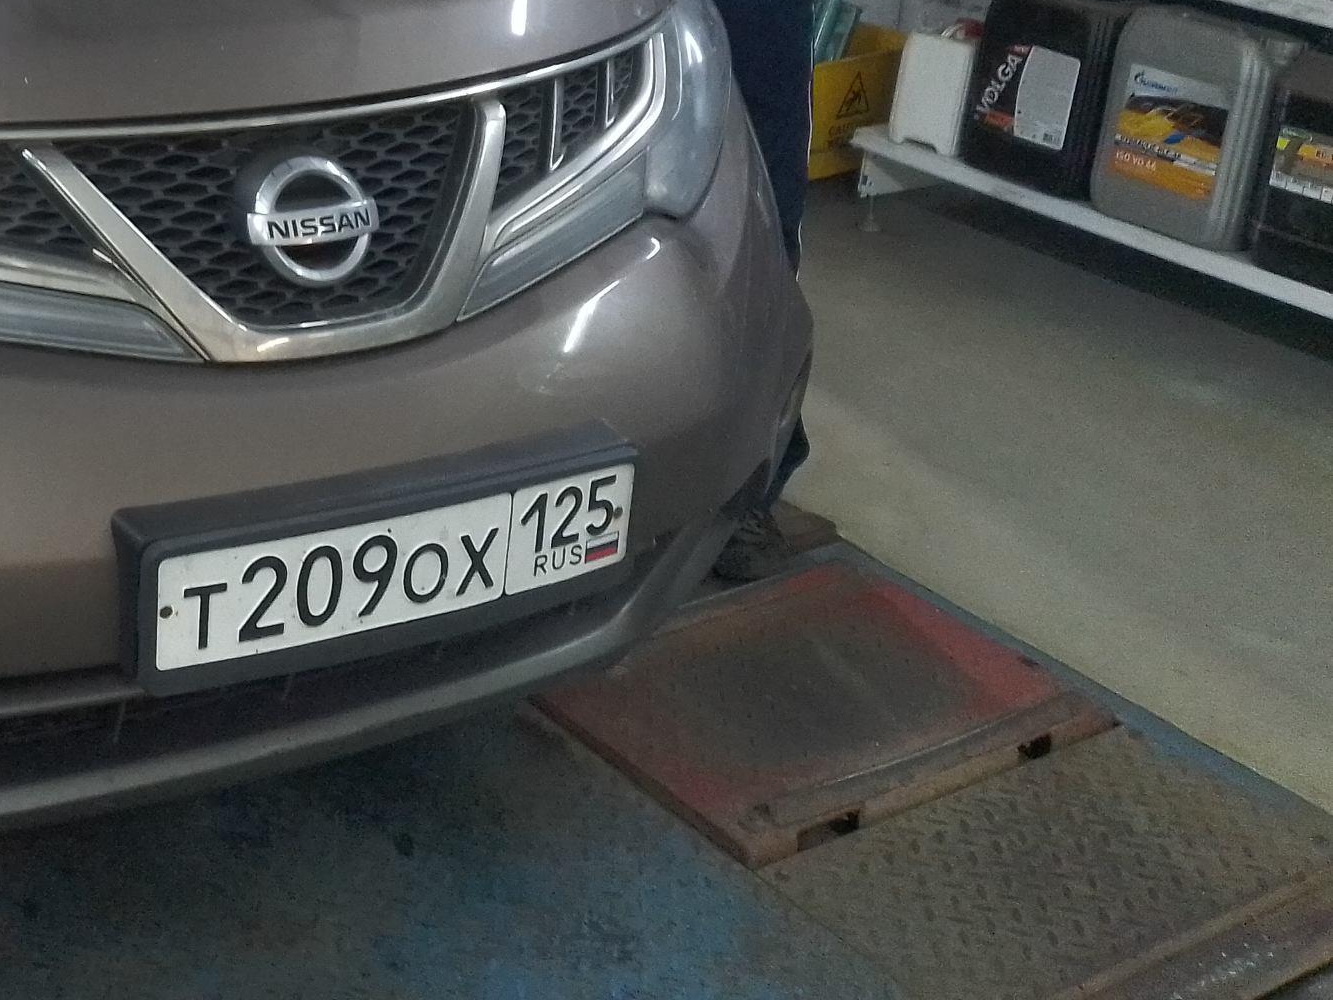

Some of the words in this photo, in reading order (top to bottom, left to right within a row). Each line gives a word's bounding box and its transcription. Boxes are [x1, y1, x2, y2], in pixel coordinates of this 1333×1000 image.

[267, 208, 371, 239] NISSAN
[519, 474, 618, 556] 125
[532, 546, 584, 578] RUS
